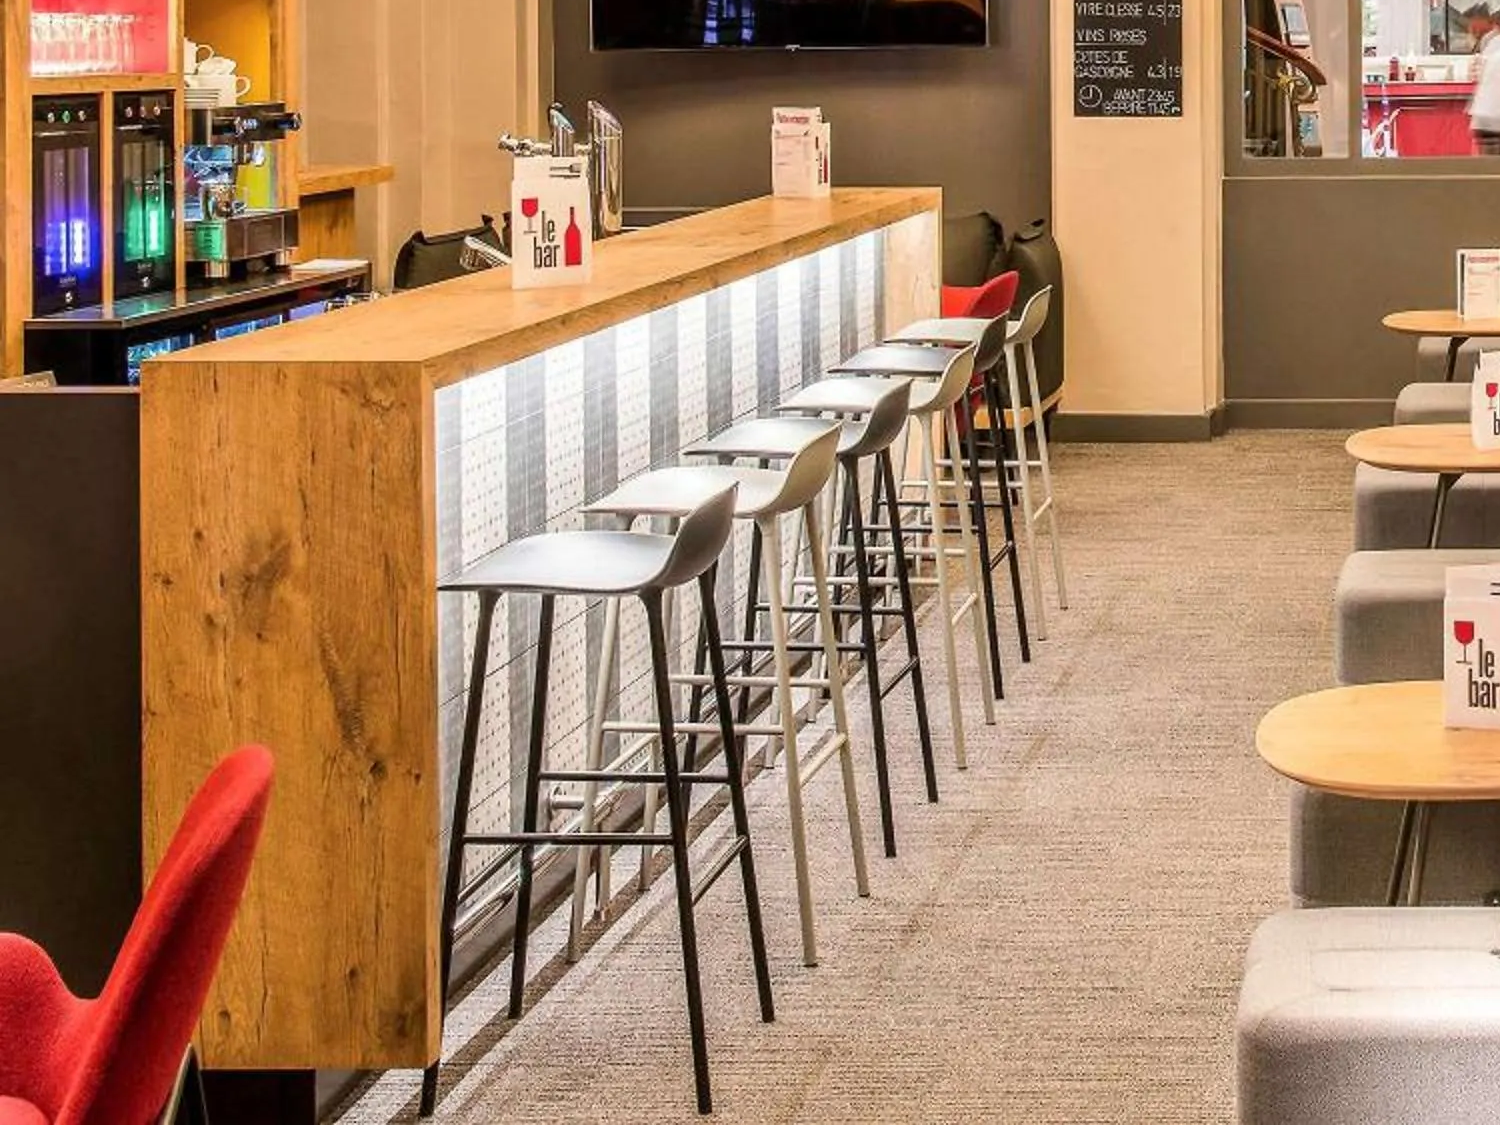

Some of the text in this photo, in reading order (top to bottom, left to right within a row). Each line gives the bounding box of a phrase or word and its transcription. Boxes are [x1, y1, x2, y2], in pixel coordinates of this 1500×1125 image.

[1076, 28, 1105, 43] VINS
[1111, 50, 1128, 64] DE
[1113, 88, 1146, 100] AVANT
[541, 211, 556, 243] le
[533, 237, 561, 268] bar
[1478, 638, 1495, 678] le
[1468, 668, 1500, 709] bar
